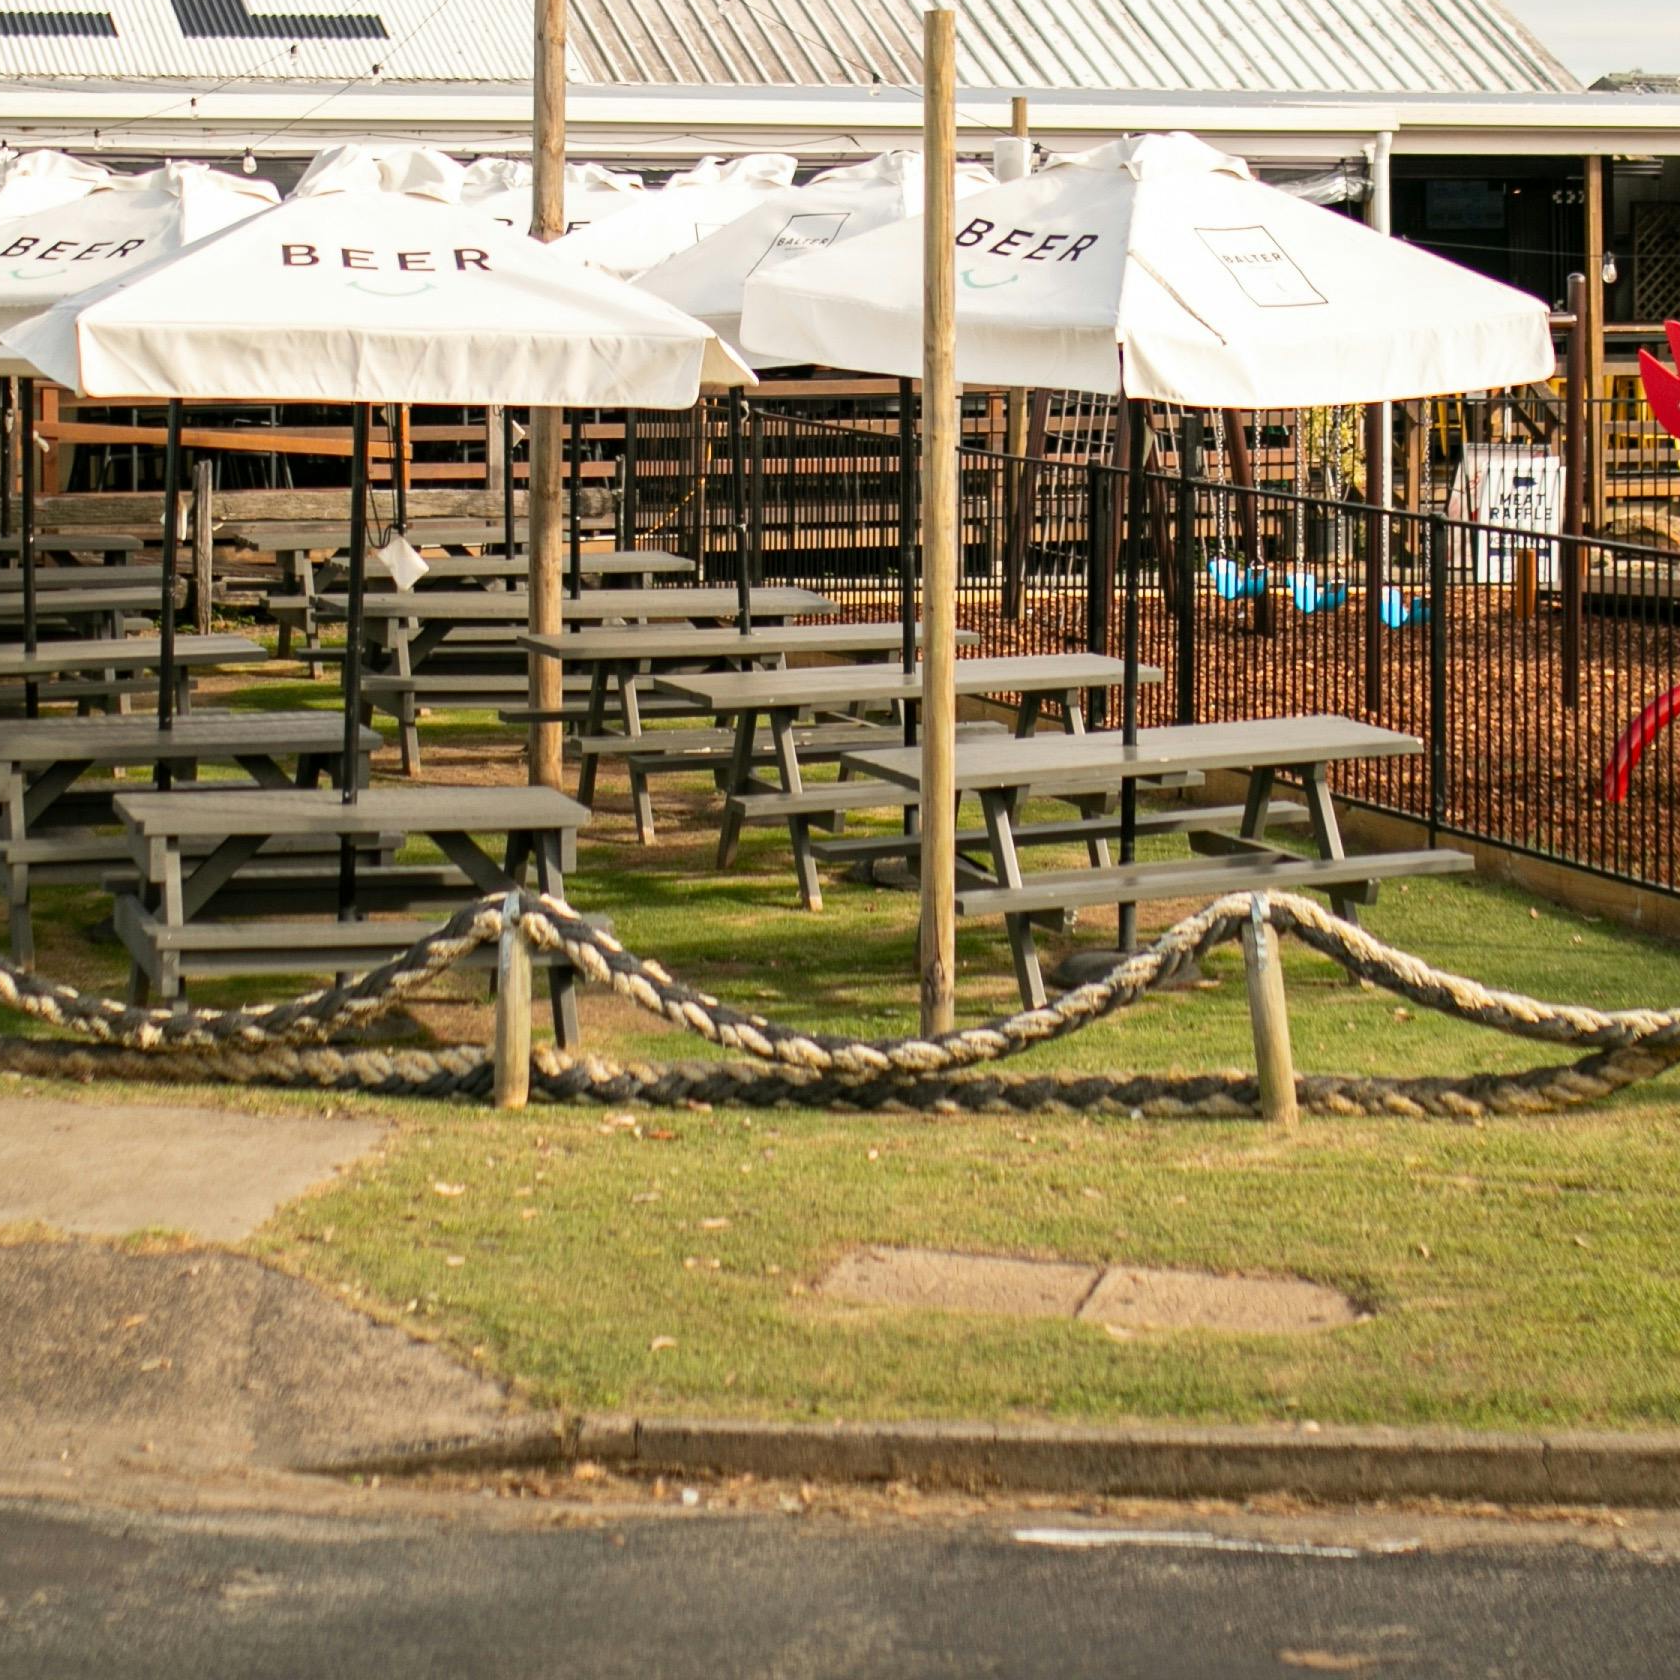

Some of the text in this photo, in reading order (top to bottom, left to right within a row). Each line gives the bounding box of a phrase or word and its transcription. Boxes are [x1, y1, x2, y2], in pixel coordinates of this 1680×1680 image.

[955, 218, 1099, 261] BEER
[281, 243, 493, 271] BEER
[1222, 252, 1281, 263] BALTER
[1500, 493, 1546, 507] MEAT
[1489, 507, 1552, 521] RAFFLE
